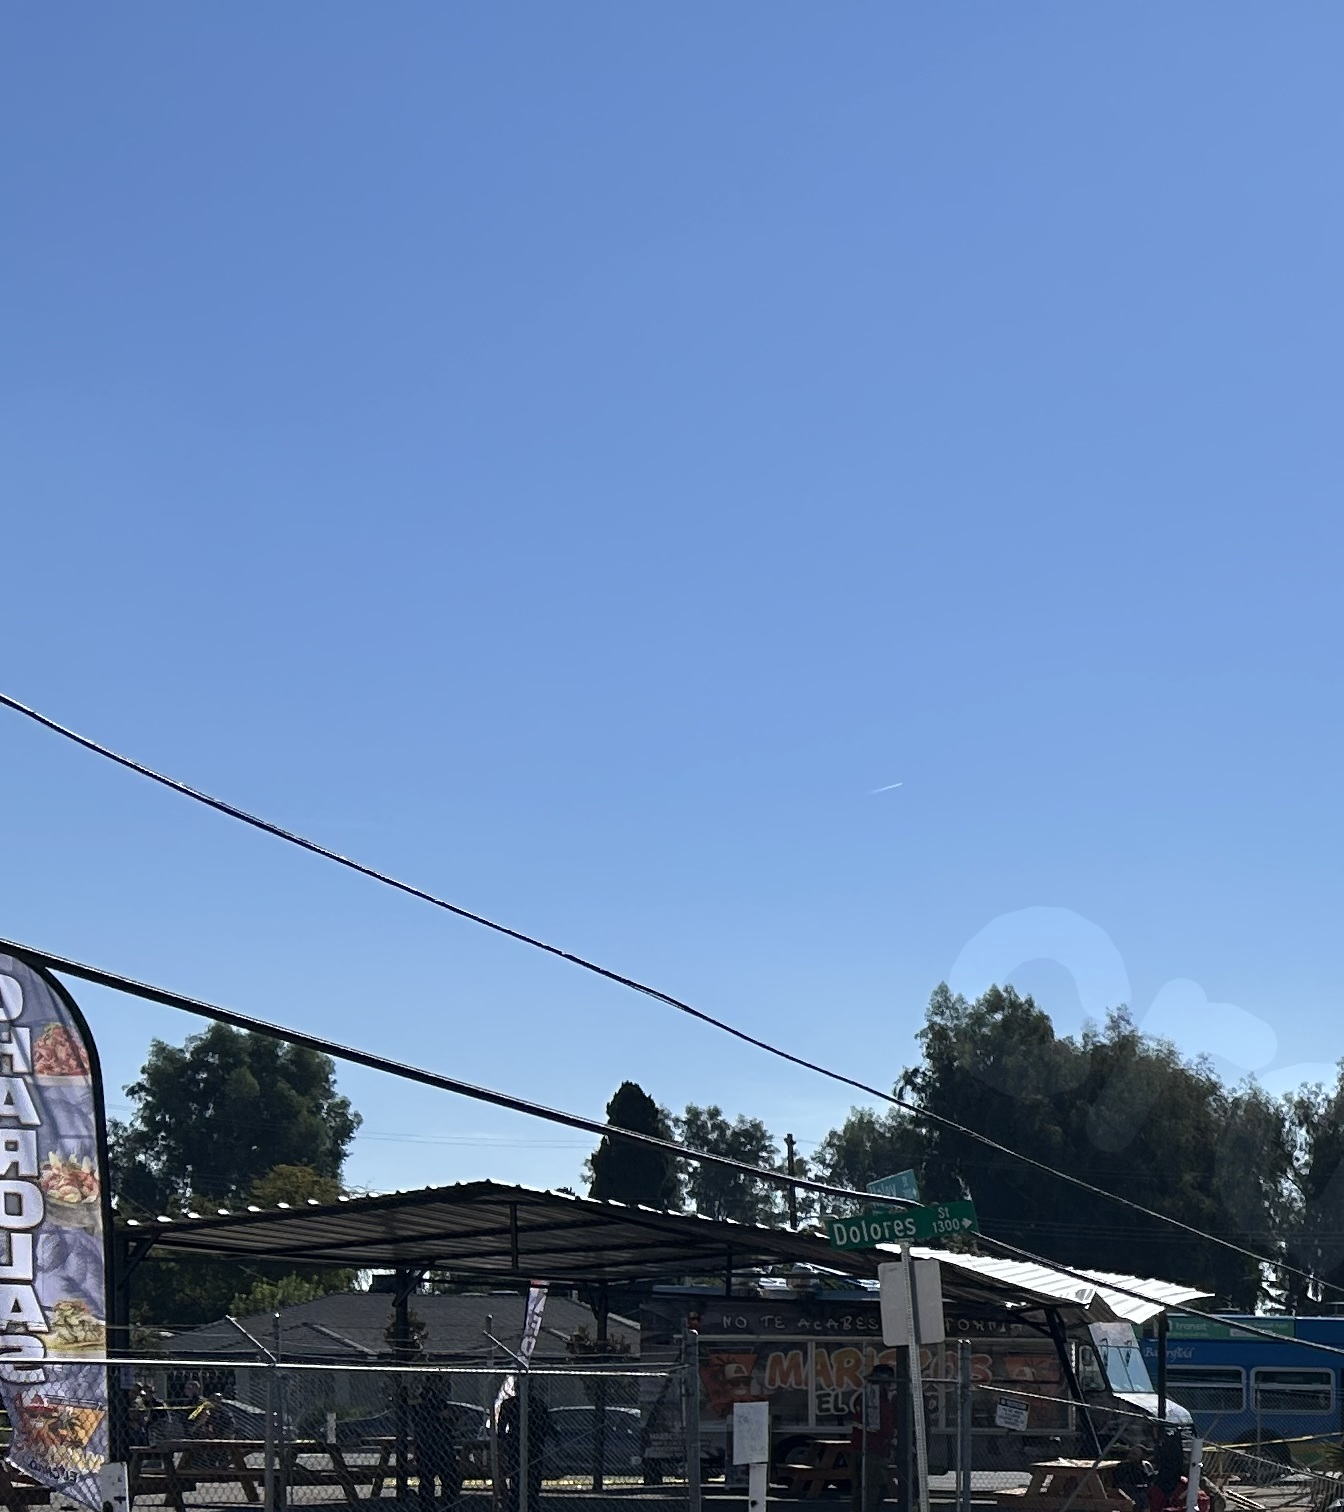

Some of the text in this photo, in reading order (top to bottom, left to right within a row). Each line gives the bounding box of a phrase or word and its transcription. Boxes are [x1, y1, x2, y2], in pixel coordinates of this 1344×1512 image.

[937, 1206, 950, 1219] St
[833, 1217, 917, 1247] Dolores
[932, 1218, 960, 1234] 1300
[722, 1315, 747, 1329] NO
[760, 1315, 785, 1329] TE
[797, 1316, 879, 1330] ACABES
[1175, 1322, 1208, 1331] transit
